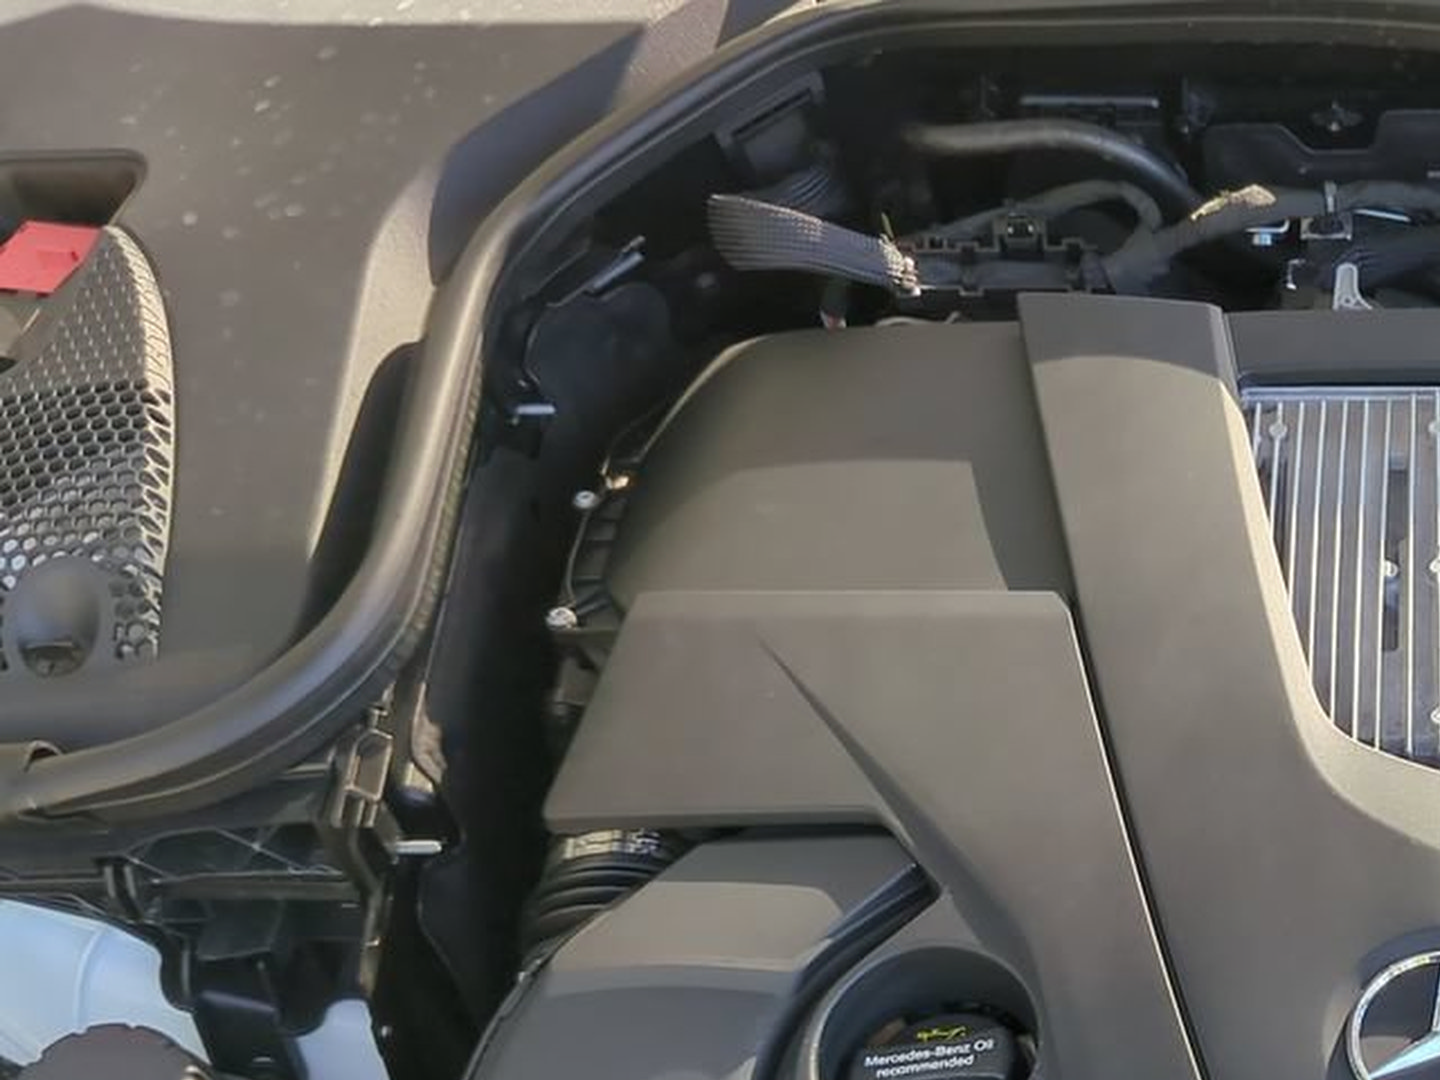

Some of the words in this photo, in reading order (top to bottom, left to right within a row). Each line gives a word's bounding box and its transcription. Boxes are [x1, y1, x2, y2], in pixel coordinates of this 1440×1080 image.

[864, 1042, 971, 1067] Mercedes-Benz
[973, 1038, 995, 1052] Oil
[876, 1054, 974, 1079] recommended
